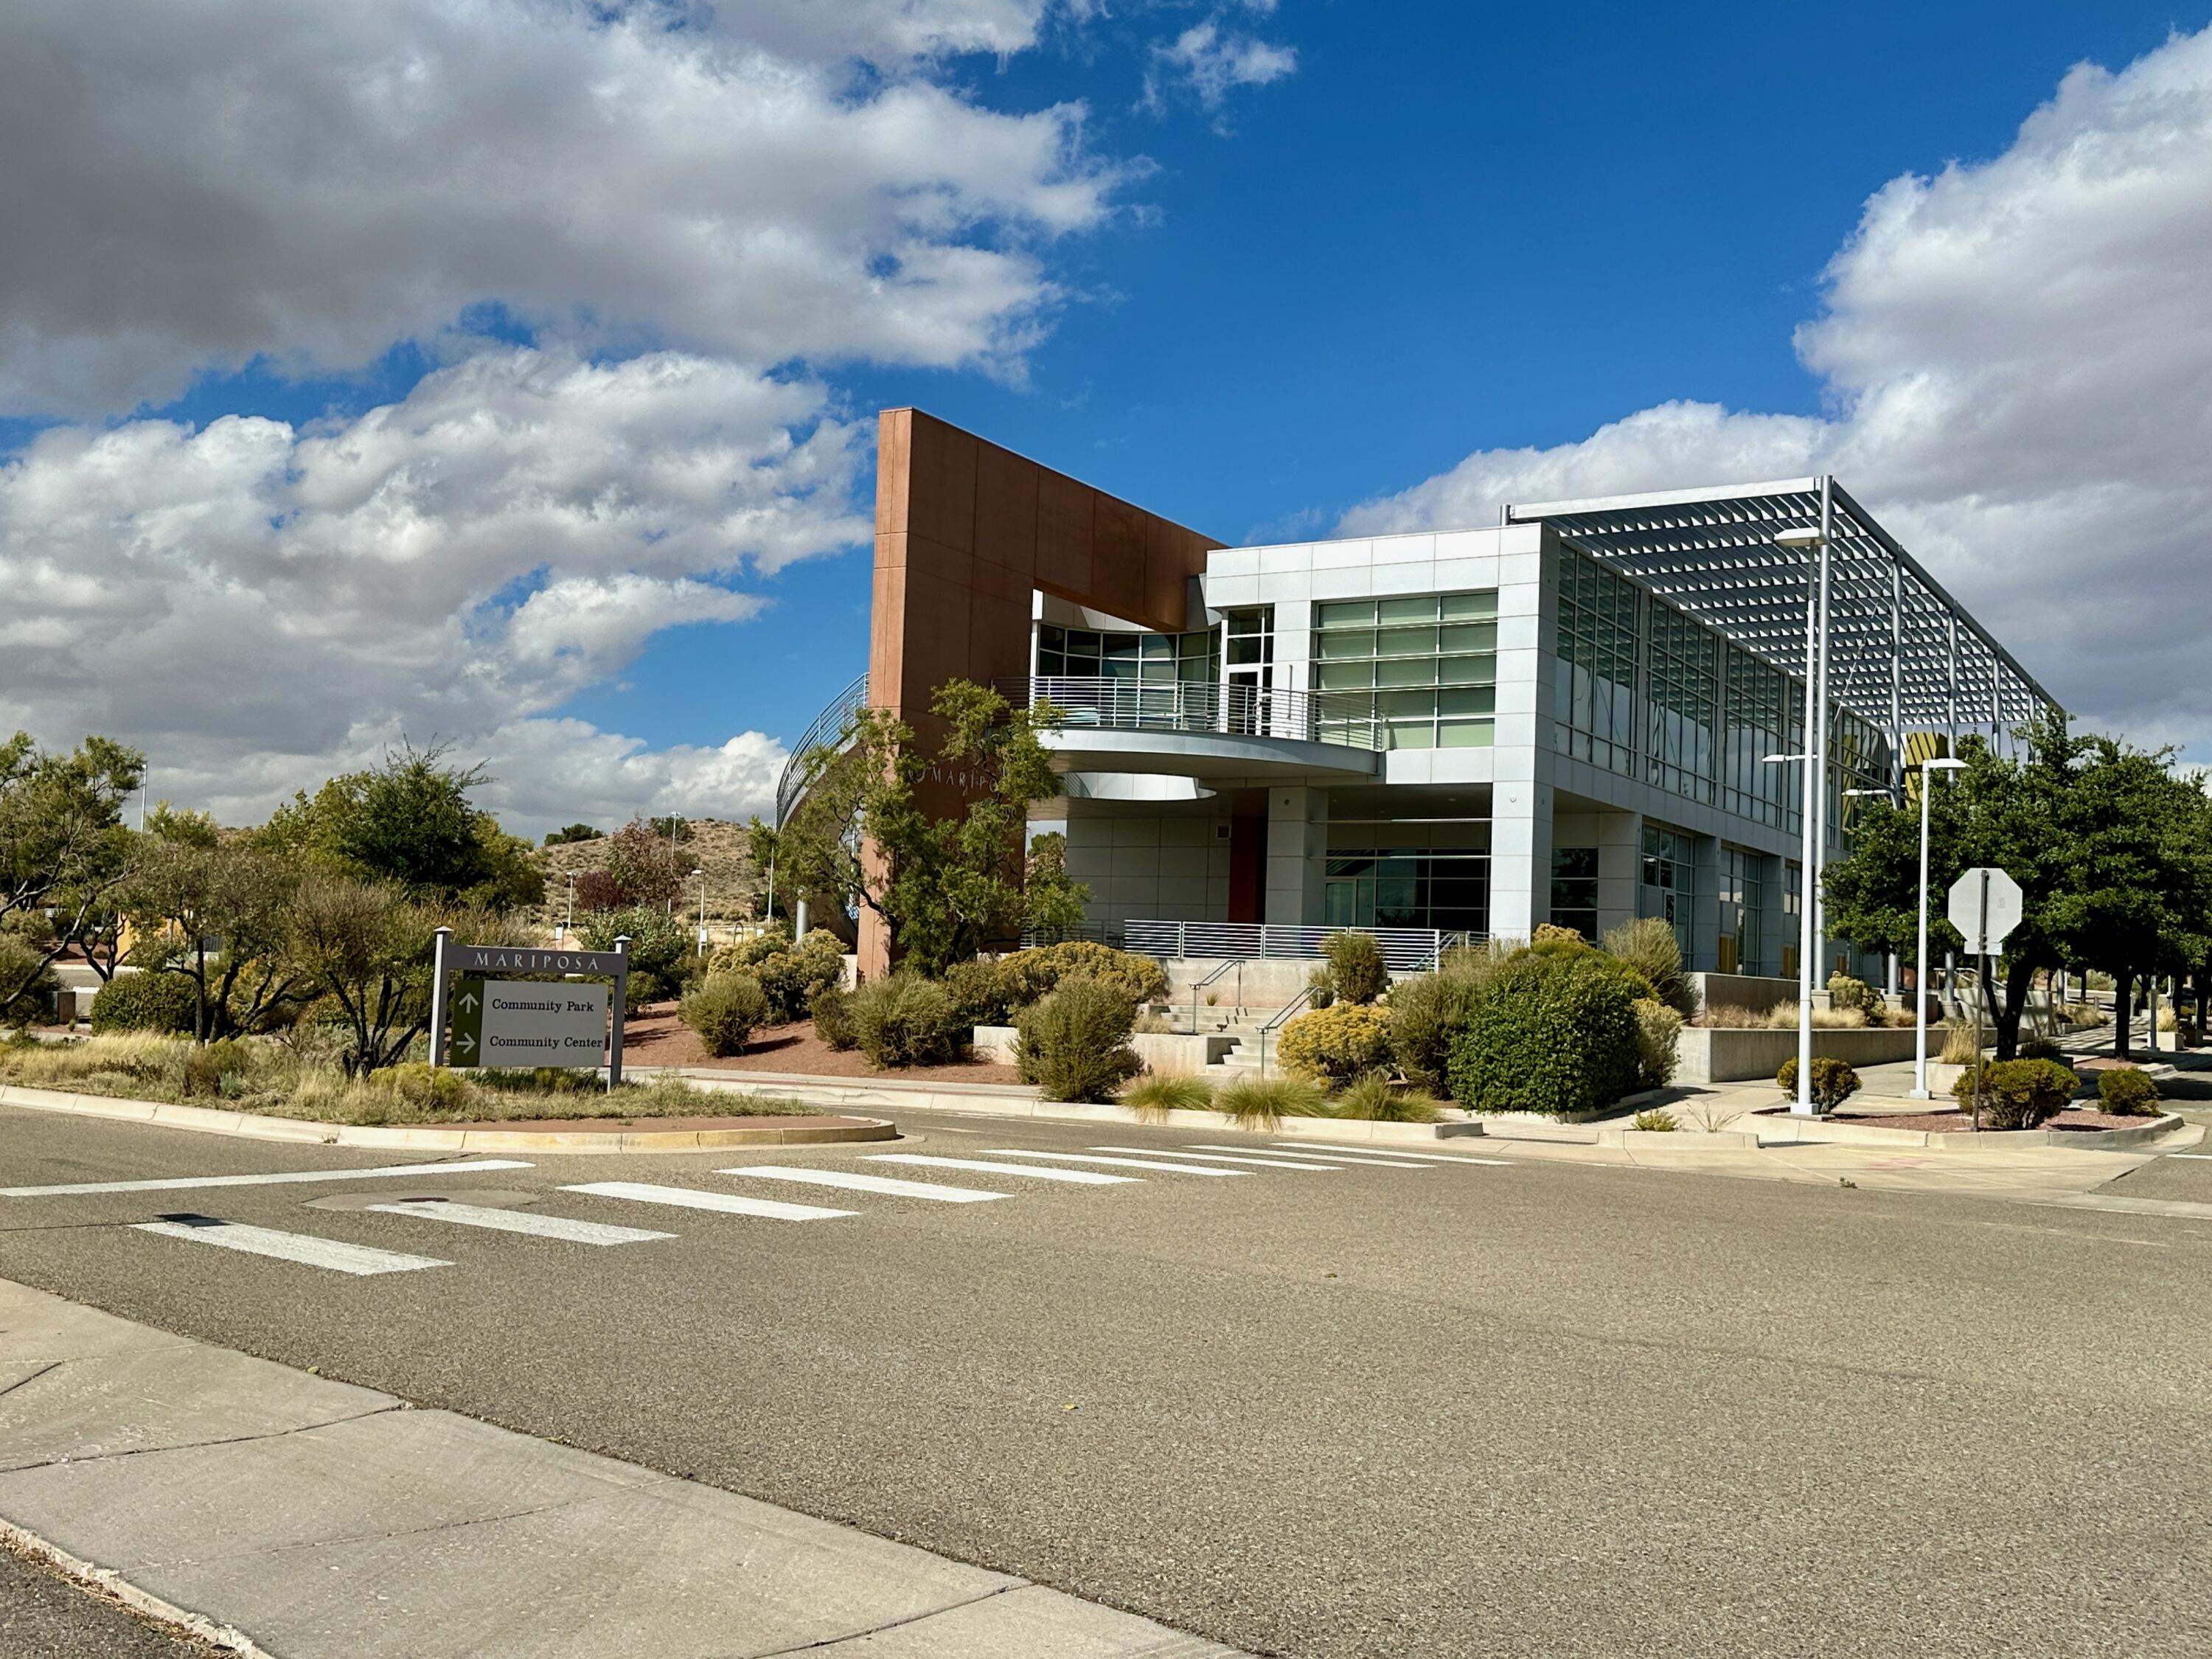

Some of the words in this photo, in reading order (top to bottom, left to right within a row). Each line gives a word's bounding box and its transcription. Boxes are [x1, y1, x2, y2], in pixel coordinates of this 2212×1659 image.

[931, 766, 1000, 793] MARIPO
[474, 952, 599, 970] MARIPOSA
[492, 998, 562, 1013] Community
[566, 1001, 594, 1012] Park
[490, 1036, 560, 1049] Community
[564, 1037, 603, 1048] Center
